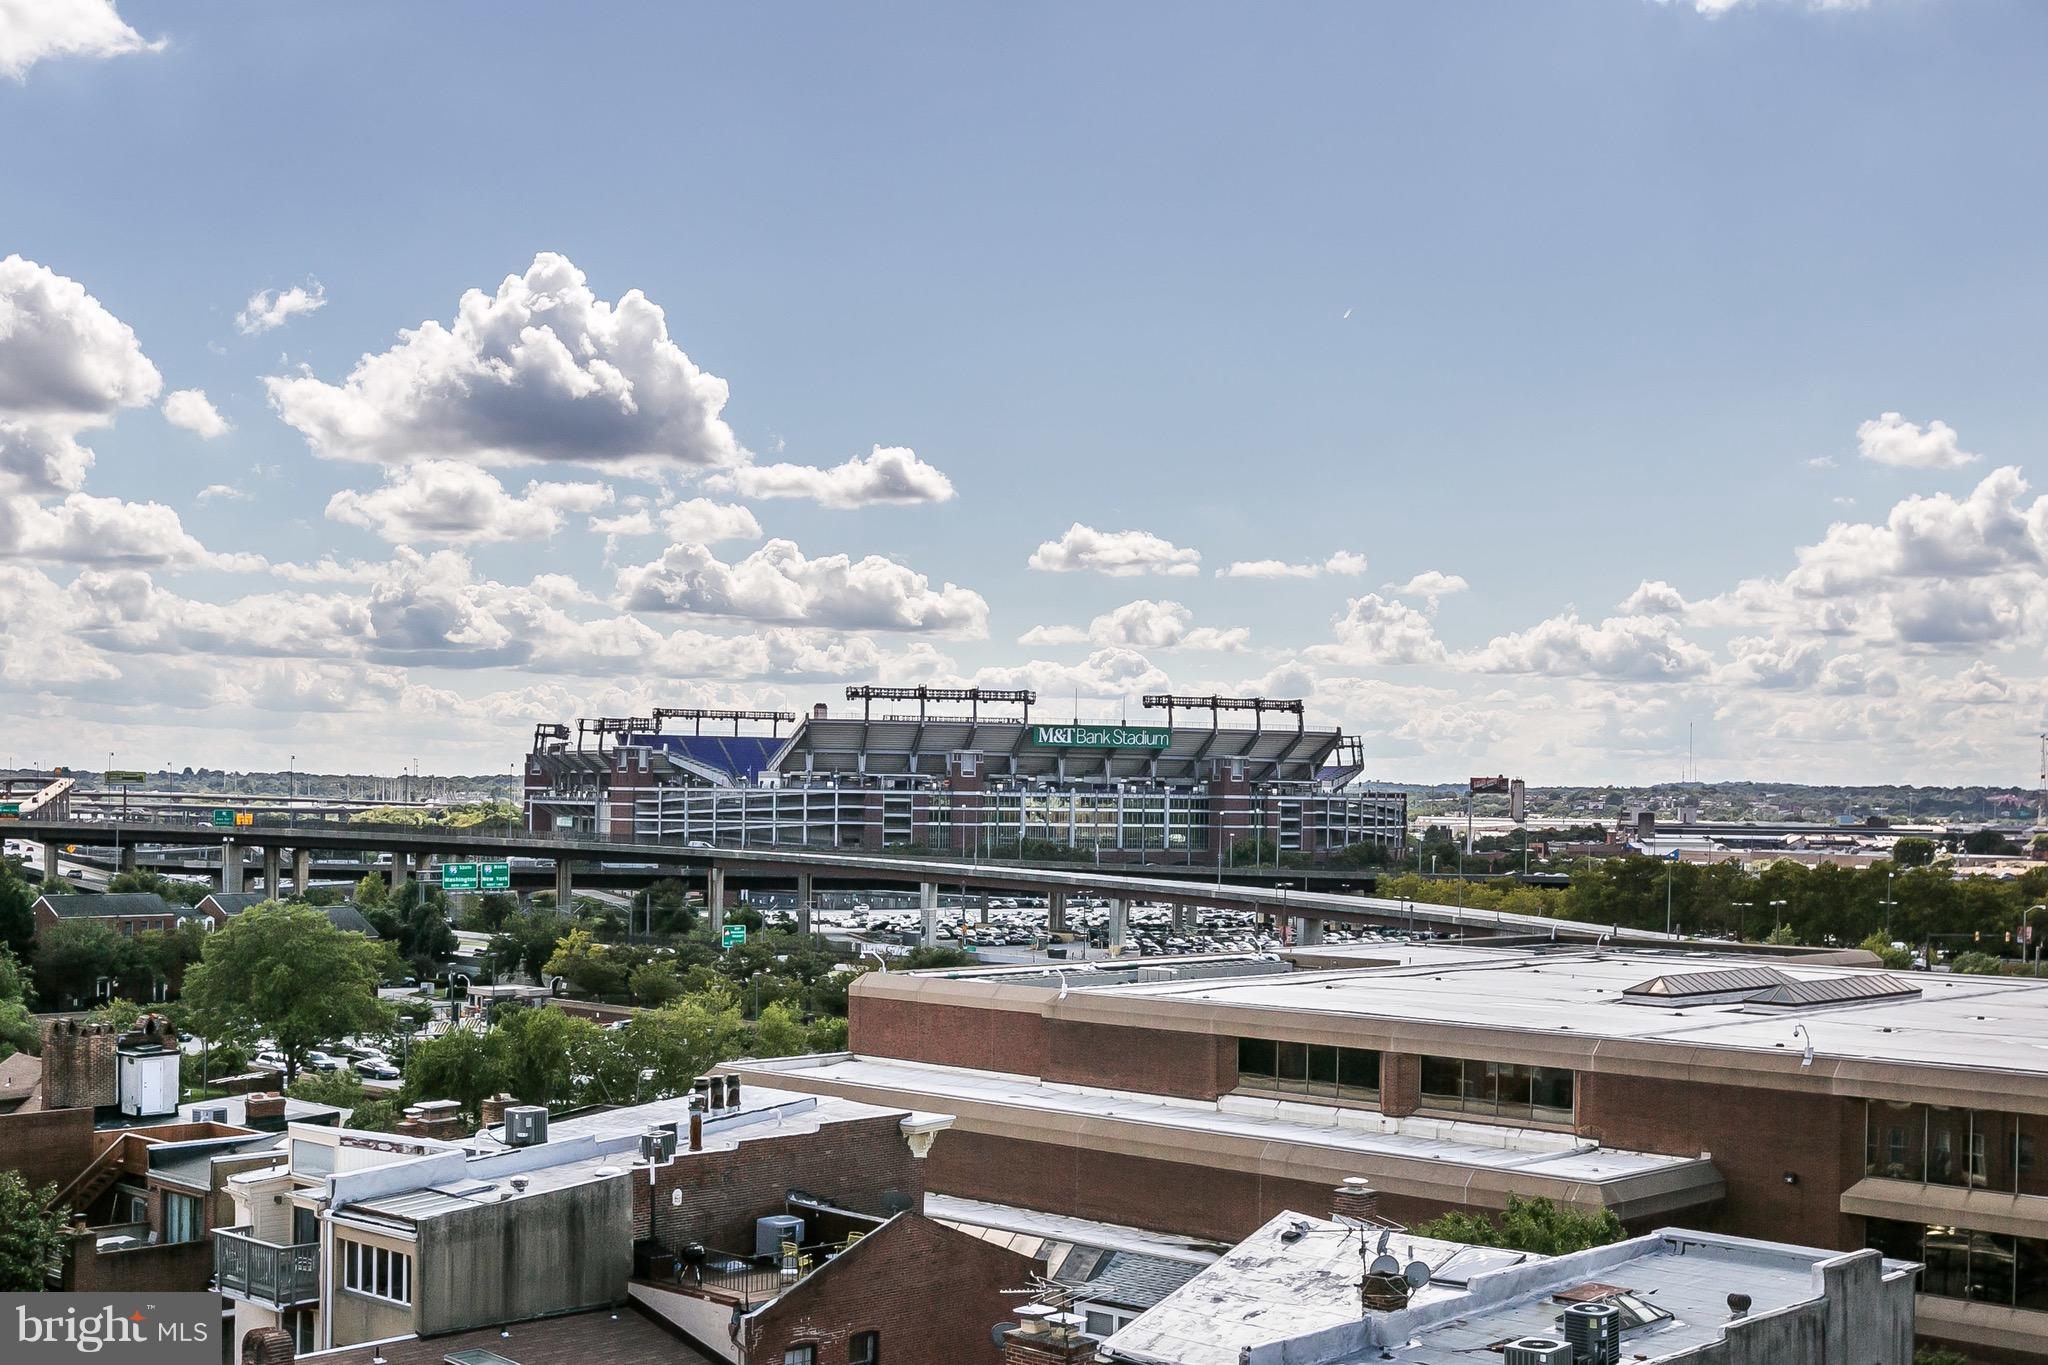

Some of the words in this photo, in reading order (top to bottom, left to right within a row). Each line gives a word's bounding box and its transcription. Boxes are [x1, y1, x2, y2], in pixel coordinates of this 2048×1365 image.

[1038, 727, 1075, 743] M&T
[1077, 728, 1111, 744] Bank
[1113, 729, 1169, 745] Stadium
